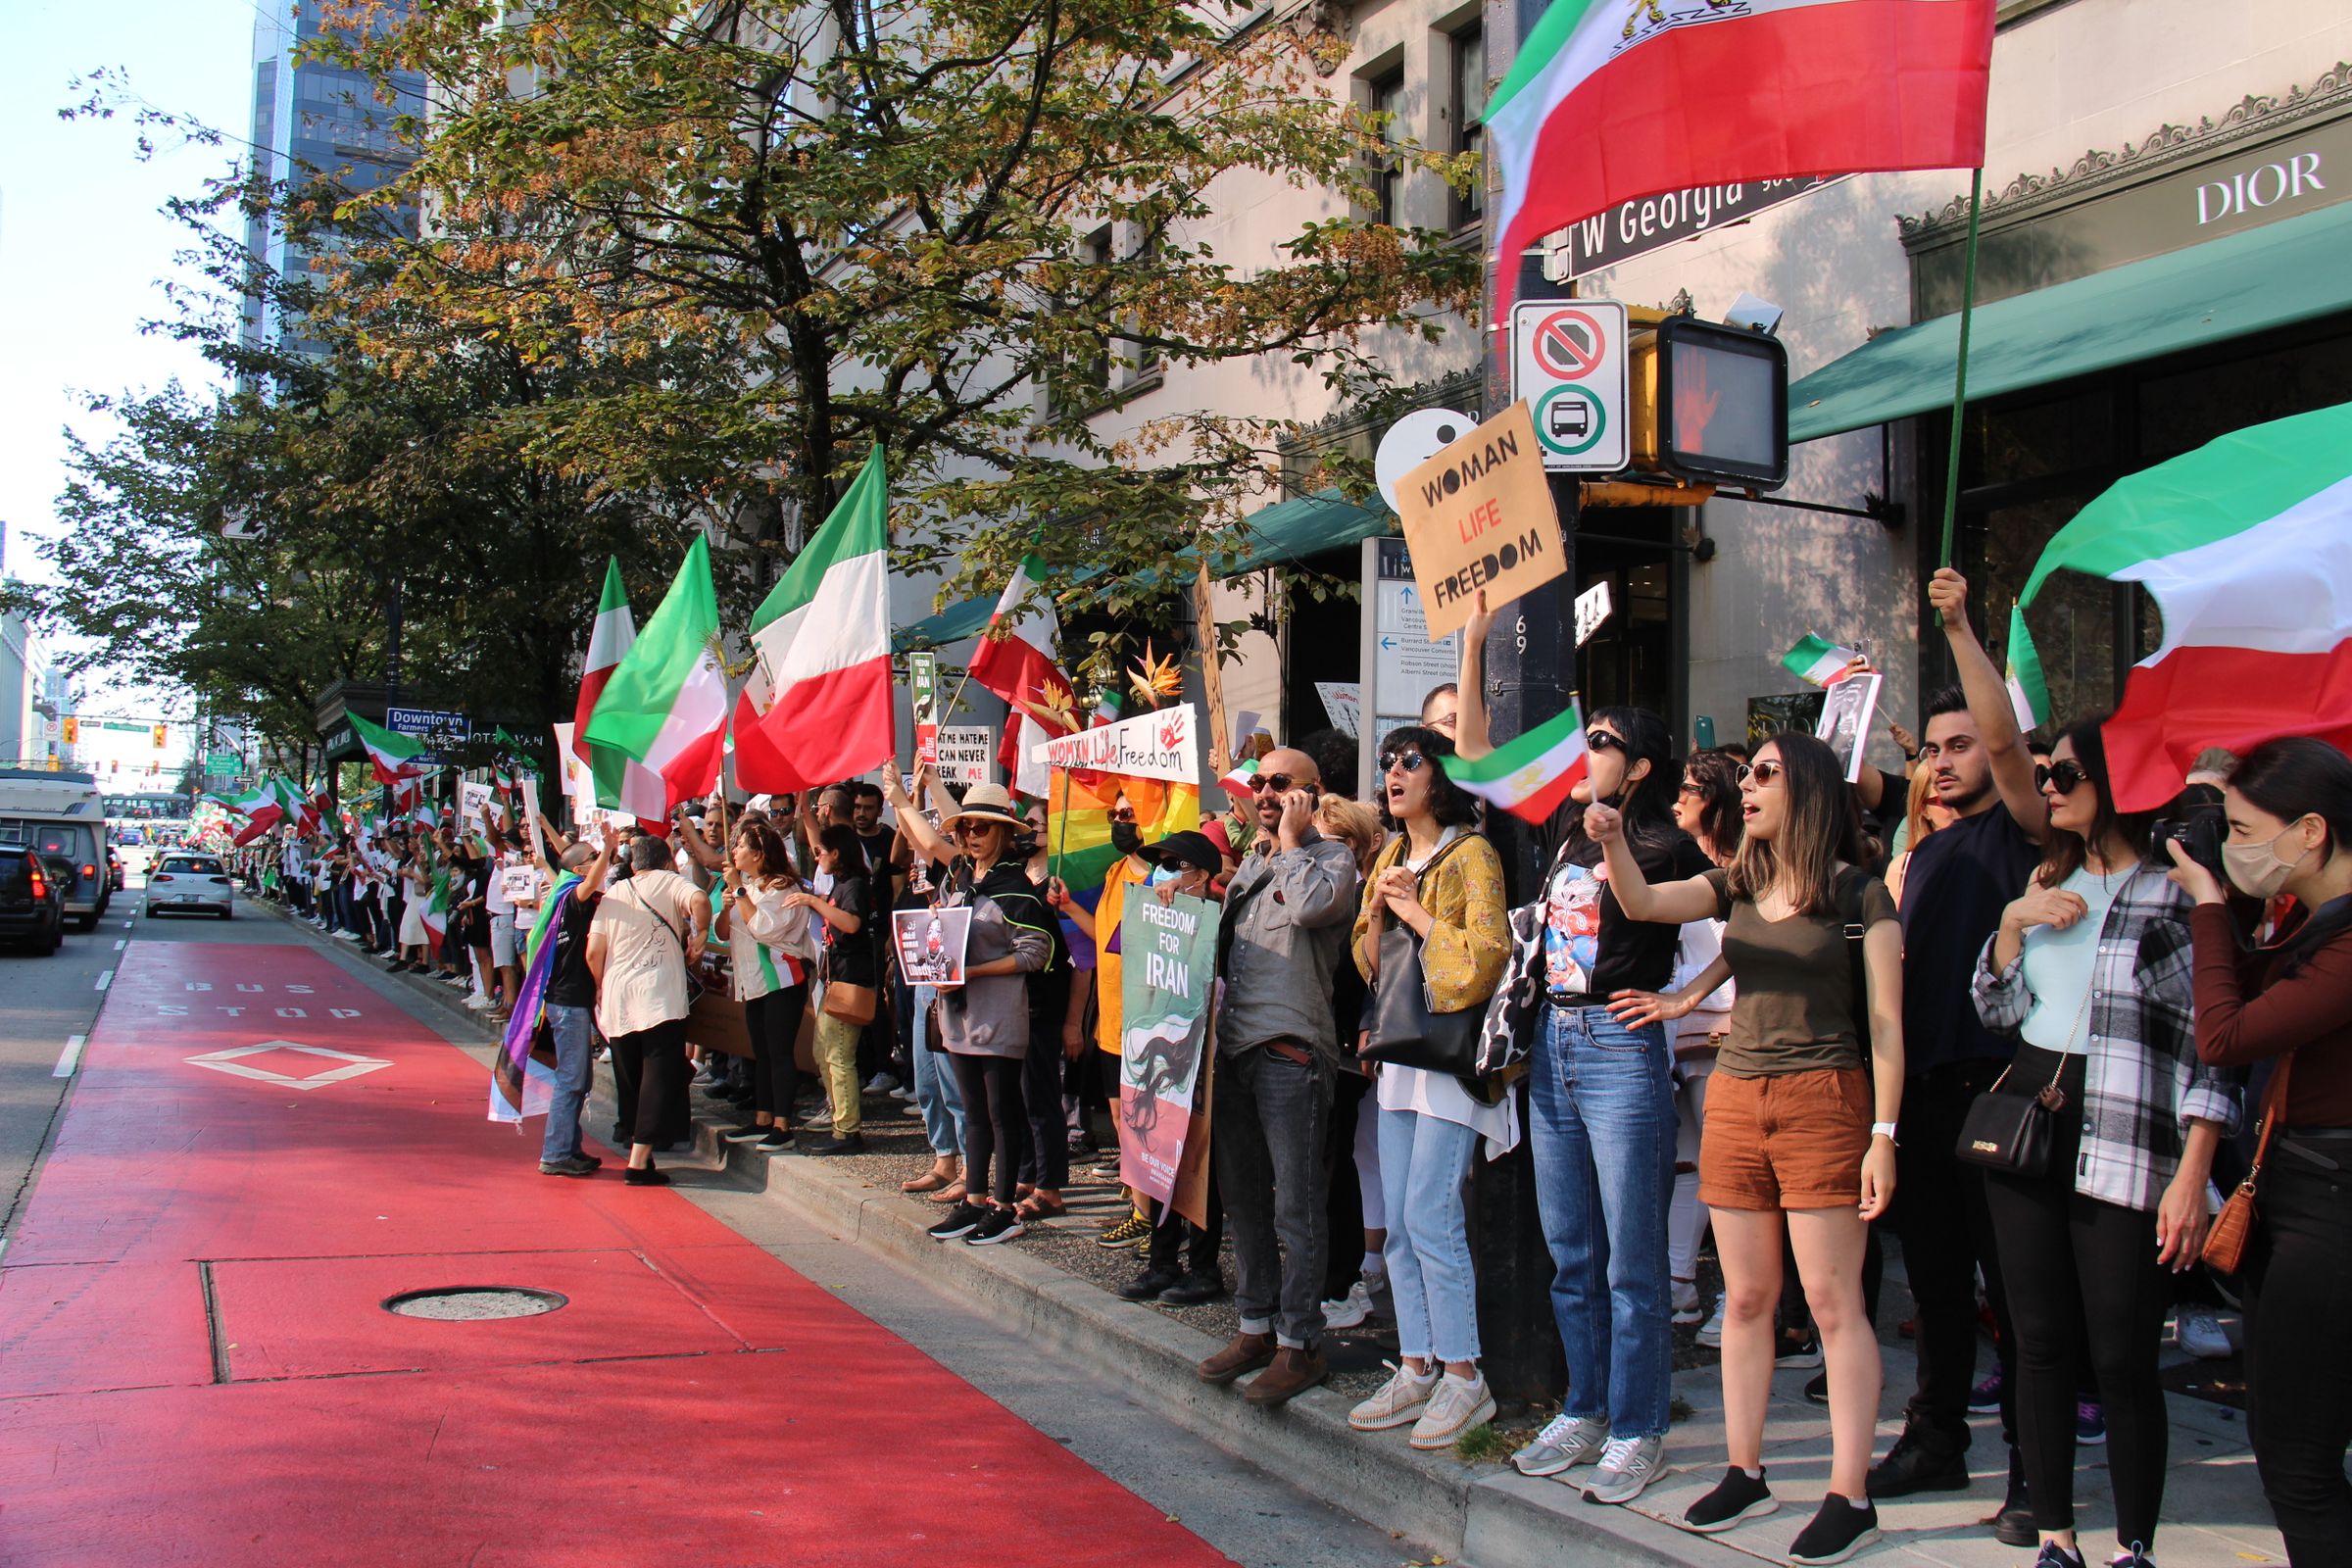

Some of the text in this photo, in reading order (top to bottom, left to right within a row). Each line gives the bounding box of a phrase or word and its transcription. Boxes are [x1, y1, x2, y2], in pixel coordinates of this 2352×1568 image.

[2196, 153, 2326, 225] DIOR
[1581, 212, 1606, 258] W
[1619, 182, 1742, 244] Georgia
[1421, 429, 1518, 508] WOMAN
[1458, 498, 1502, 545] LIFE
[1434, 528, 1543, 609] FREEDOM
[398, 723, 429, 732] Farmers
[948, 733, 956, 744] ME
[960, 733, 977, 745] HATE
[978, 733, 988, 745] ME
[939, 749, 985, 761] CAN NEVER
[968, 767, 983, 780] ME
[1143, 903, 1196, 936] FREEDOM
[1159, 932, 1180, 956] FOR
[185, 982, 315, 994] BUS
[1147, 952, 1189, 999] IRAN
[157, 1004, 362, 1019] STOP
[1141, 1152, 1149, 1163] BE
[1150, 1155, 1160, 1169] OUR
[1160, 1162, 1175, 1178] VOICE
